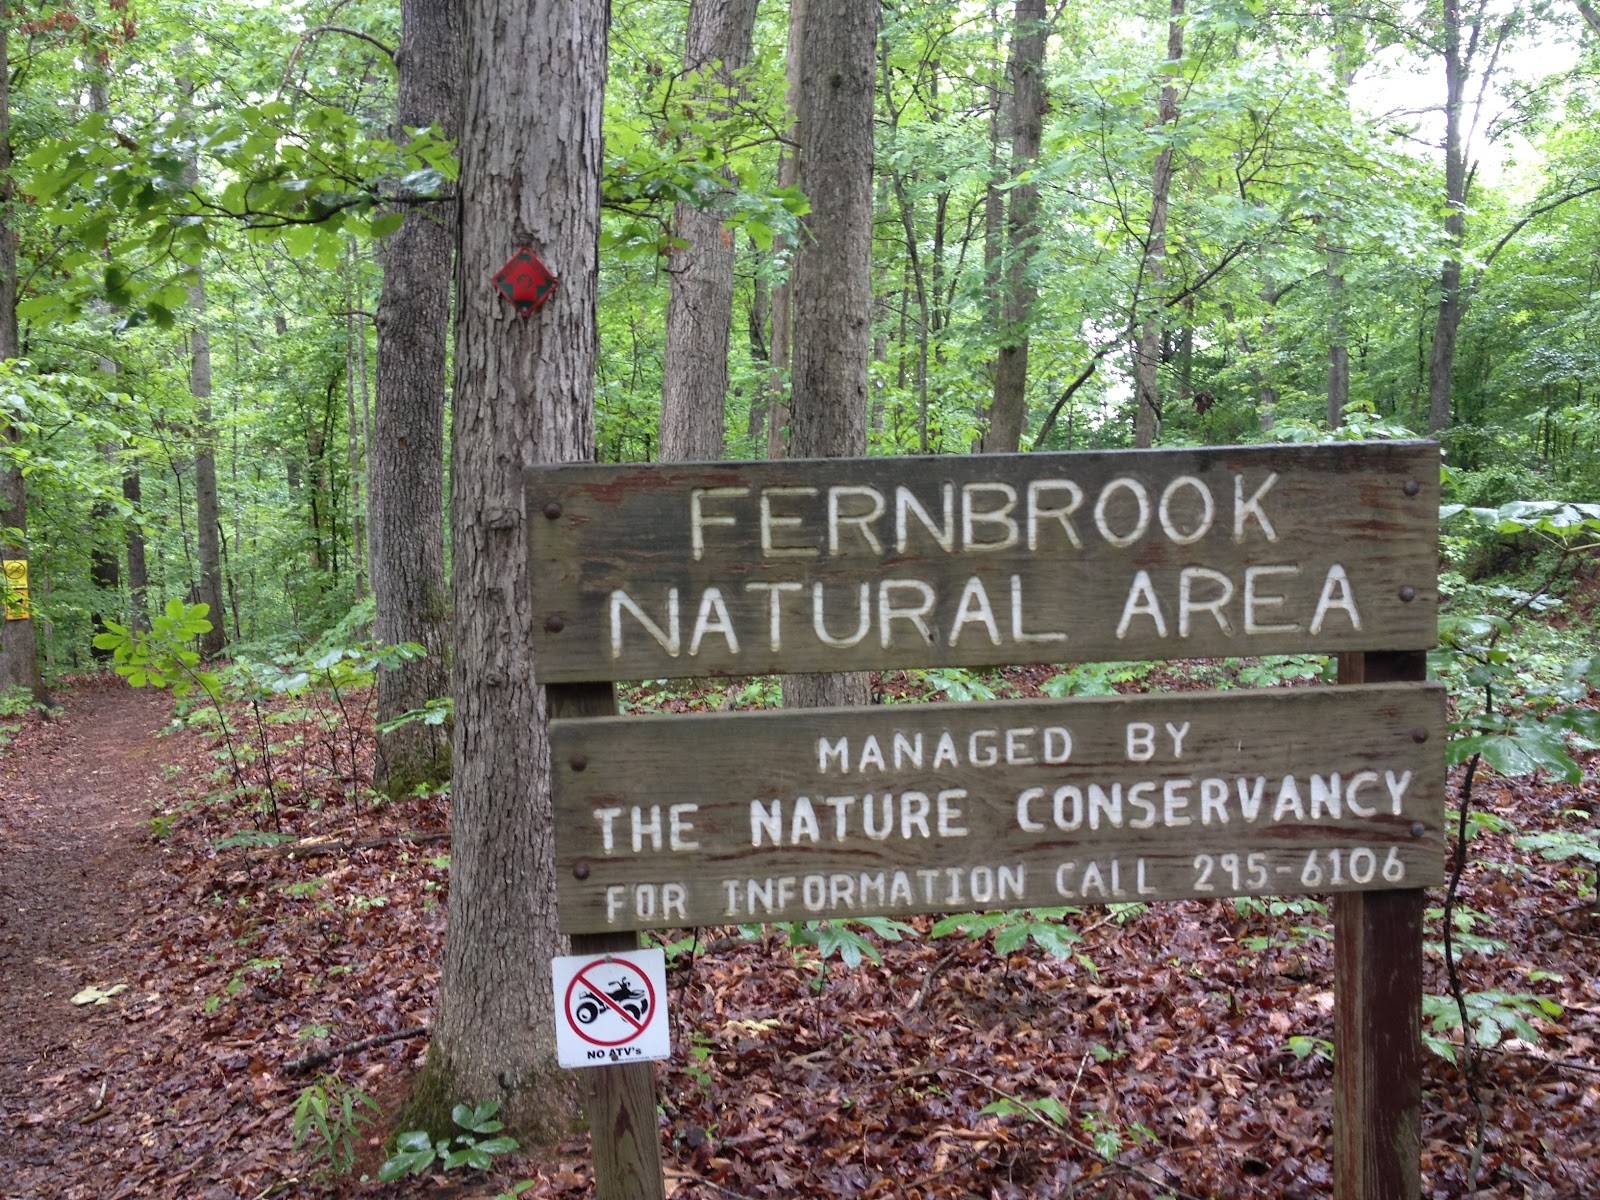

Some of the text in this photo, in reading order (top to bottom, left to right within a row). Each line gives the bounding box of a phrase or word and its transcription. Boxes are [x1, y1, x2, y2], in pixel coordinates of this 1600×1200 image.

[690, 472, 1279, 560] FERNBROOK
[610, 563, 1363, 658] NATURAL AREA
[817, 721, 1190, 774] MANAGED BY
[593, 769, 1412, 855] THE NATURE CONSERVANCY
[605, 846, 1406, 924] FOR INFORMATION CALL 295-6106
[587, 1050, 605, 1059] NO
[609, 1047, 642, 1058] ATV's
